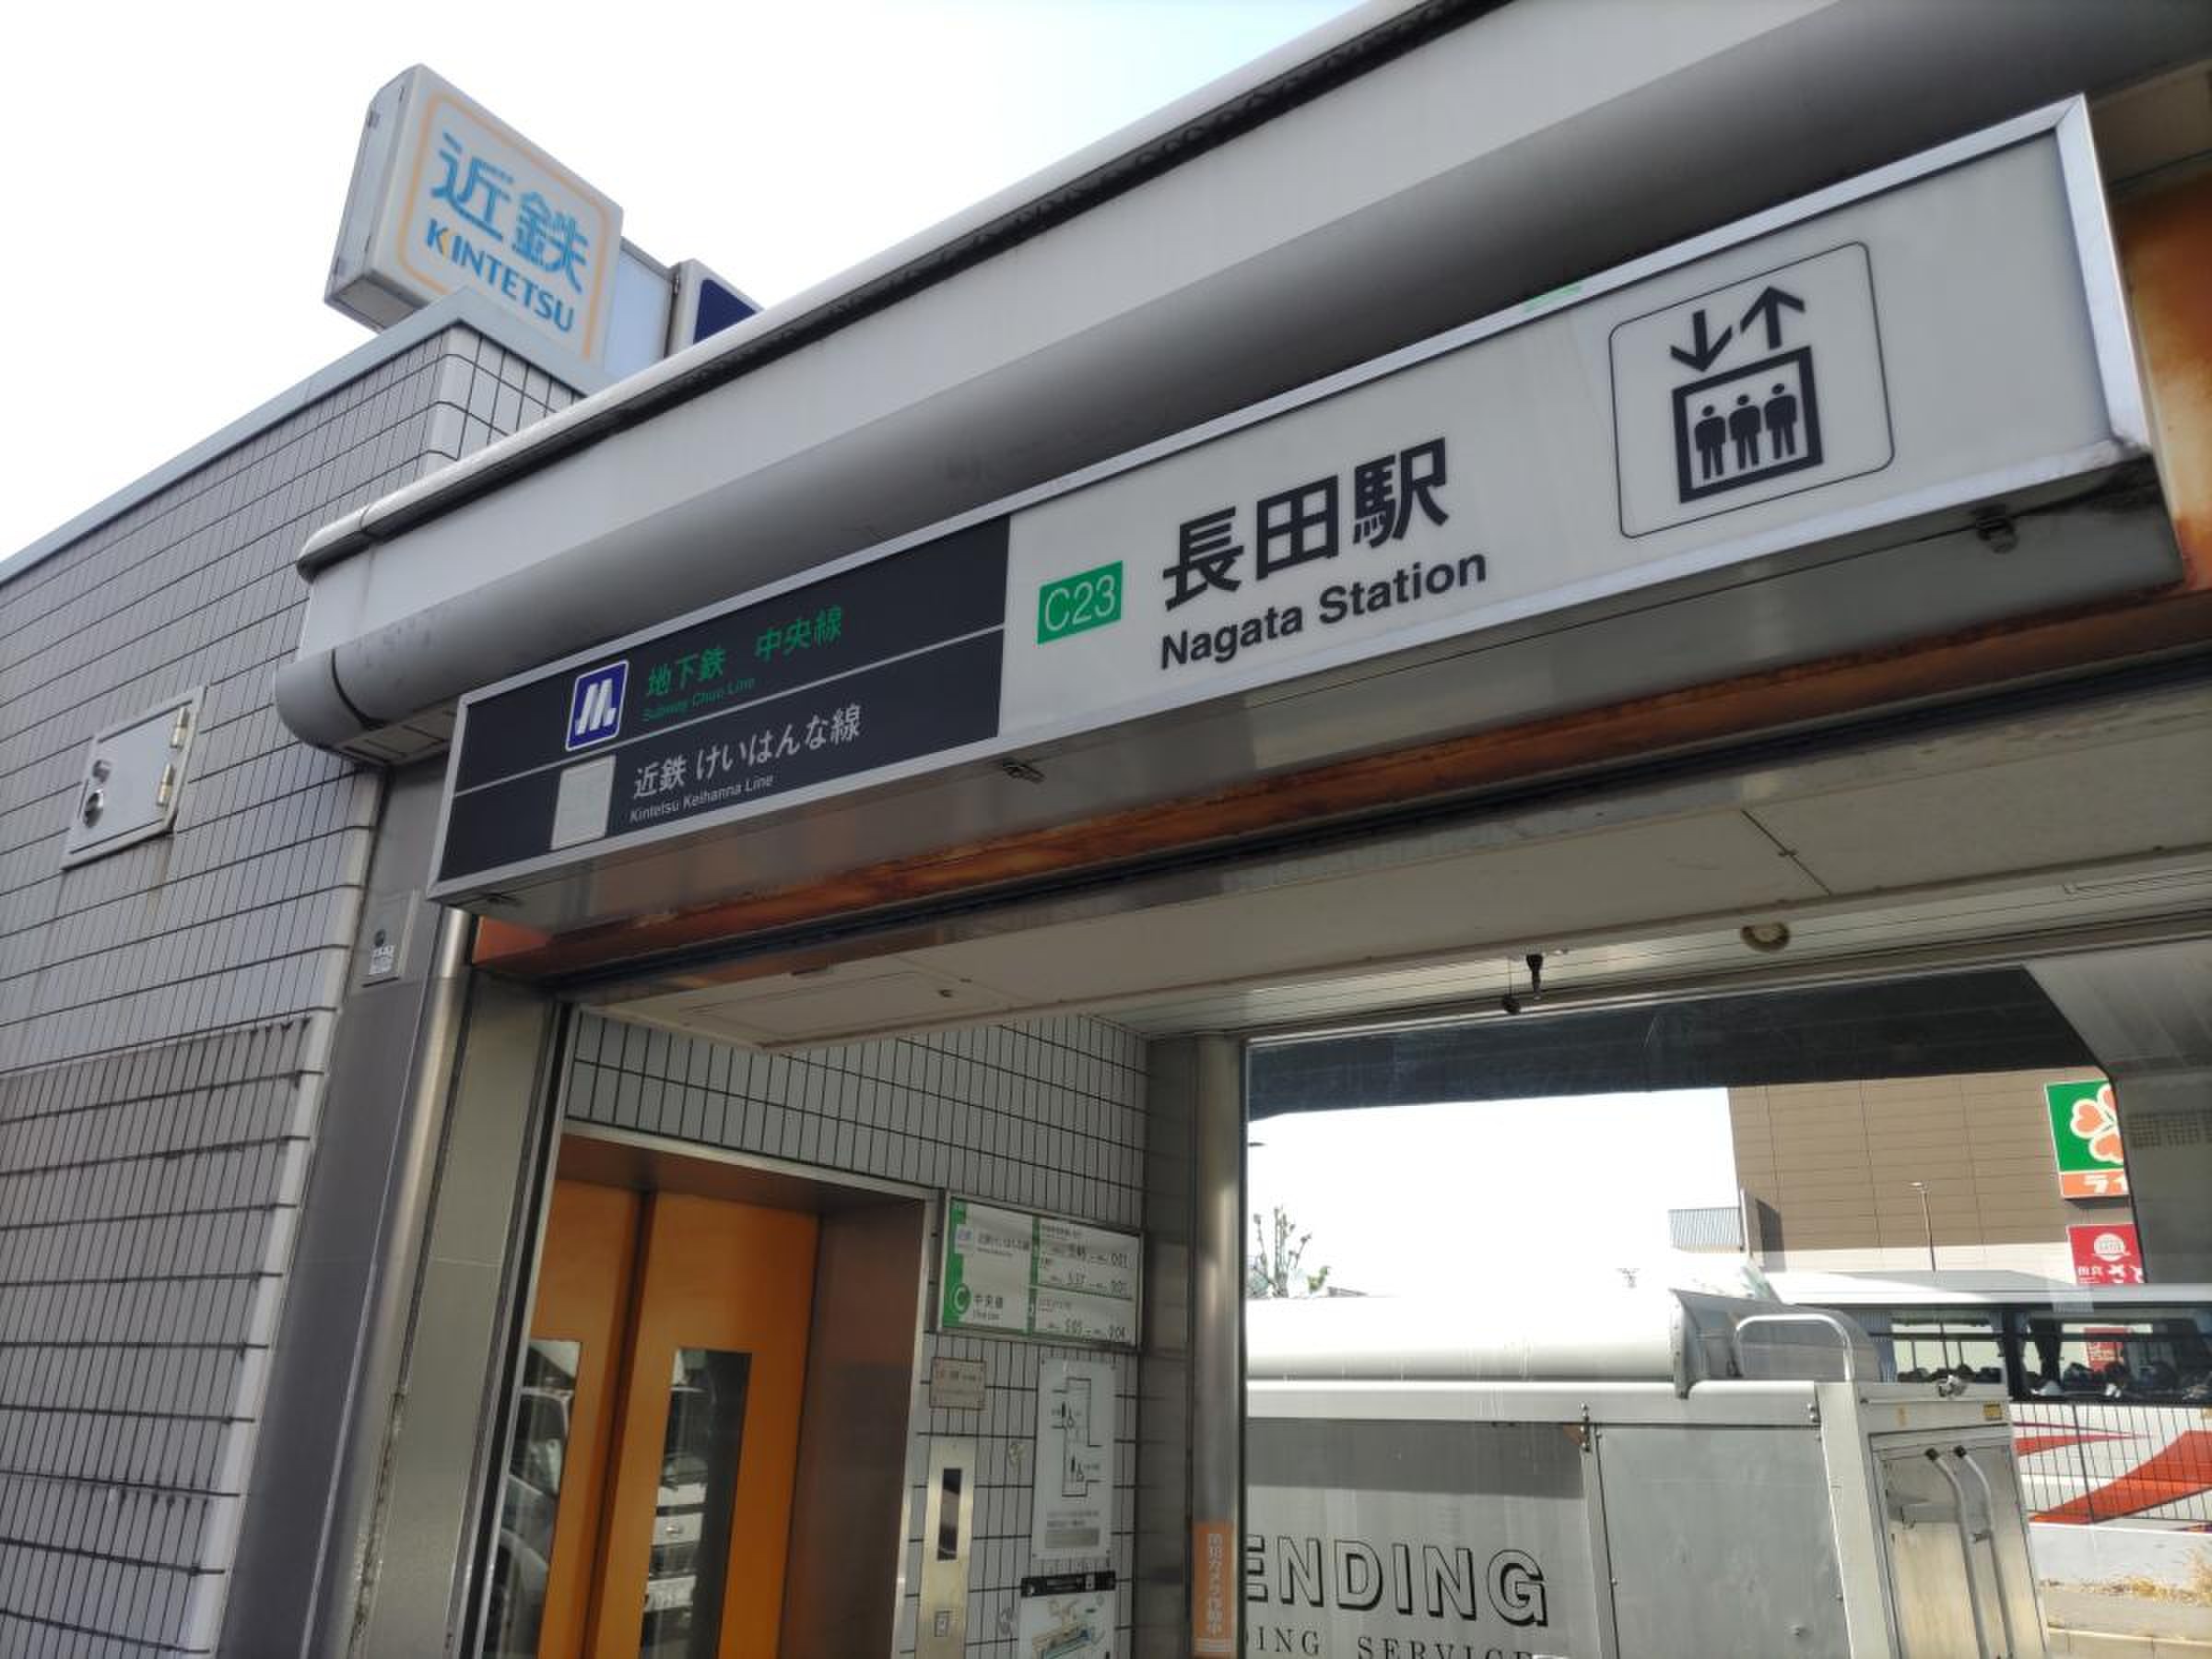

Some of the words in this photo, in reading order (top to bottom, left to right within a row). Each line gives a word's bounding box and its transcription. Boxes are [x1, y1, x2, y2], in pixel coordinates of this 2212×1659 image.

[431, 132, 588, 294] 近鉄
[426, 219, 574, 334] KINTETSU
[1161, 436, 1449, 611] 長田駅
[649, 645, 726, 697] 地下鉄
[754, 605, 843, 664] 中央線
[1043, 574, 1116, 632] C23
[1160, 601, 1303, 669] Nagata
[1318, 552, 1487, 625] Station
[629, 800, 679, 823] Kintetsu
[683, 782, 741, 808] Keihanna
[745, 774, 774, 794] Line
[634, 754, 688, 800] 近鉄
[696, 701, 863, 781] けいはんな線
[1245, 1625, 1319, 1656] ING
